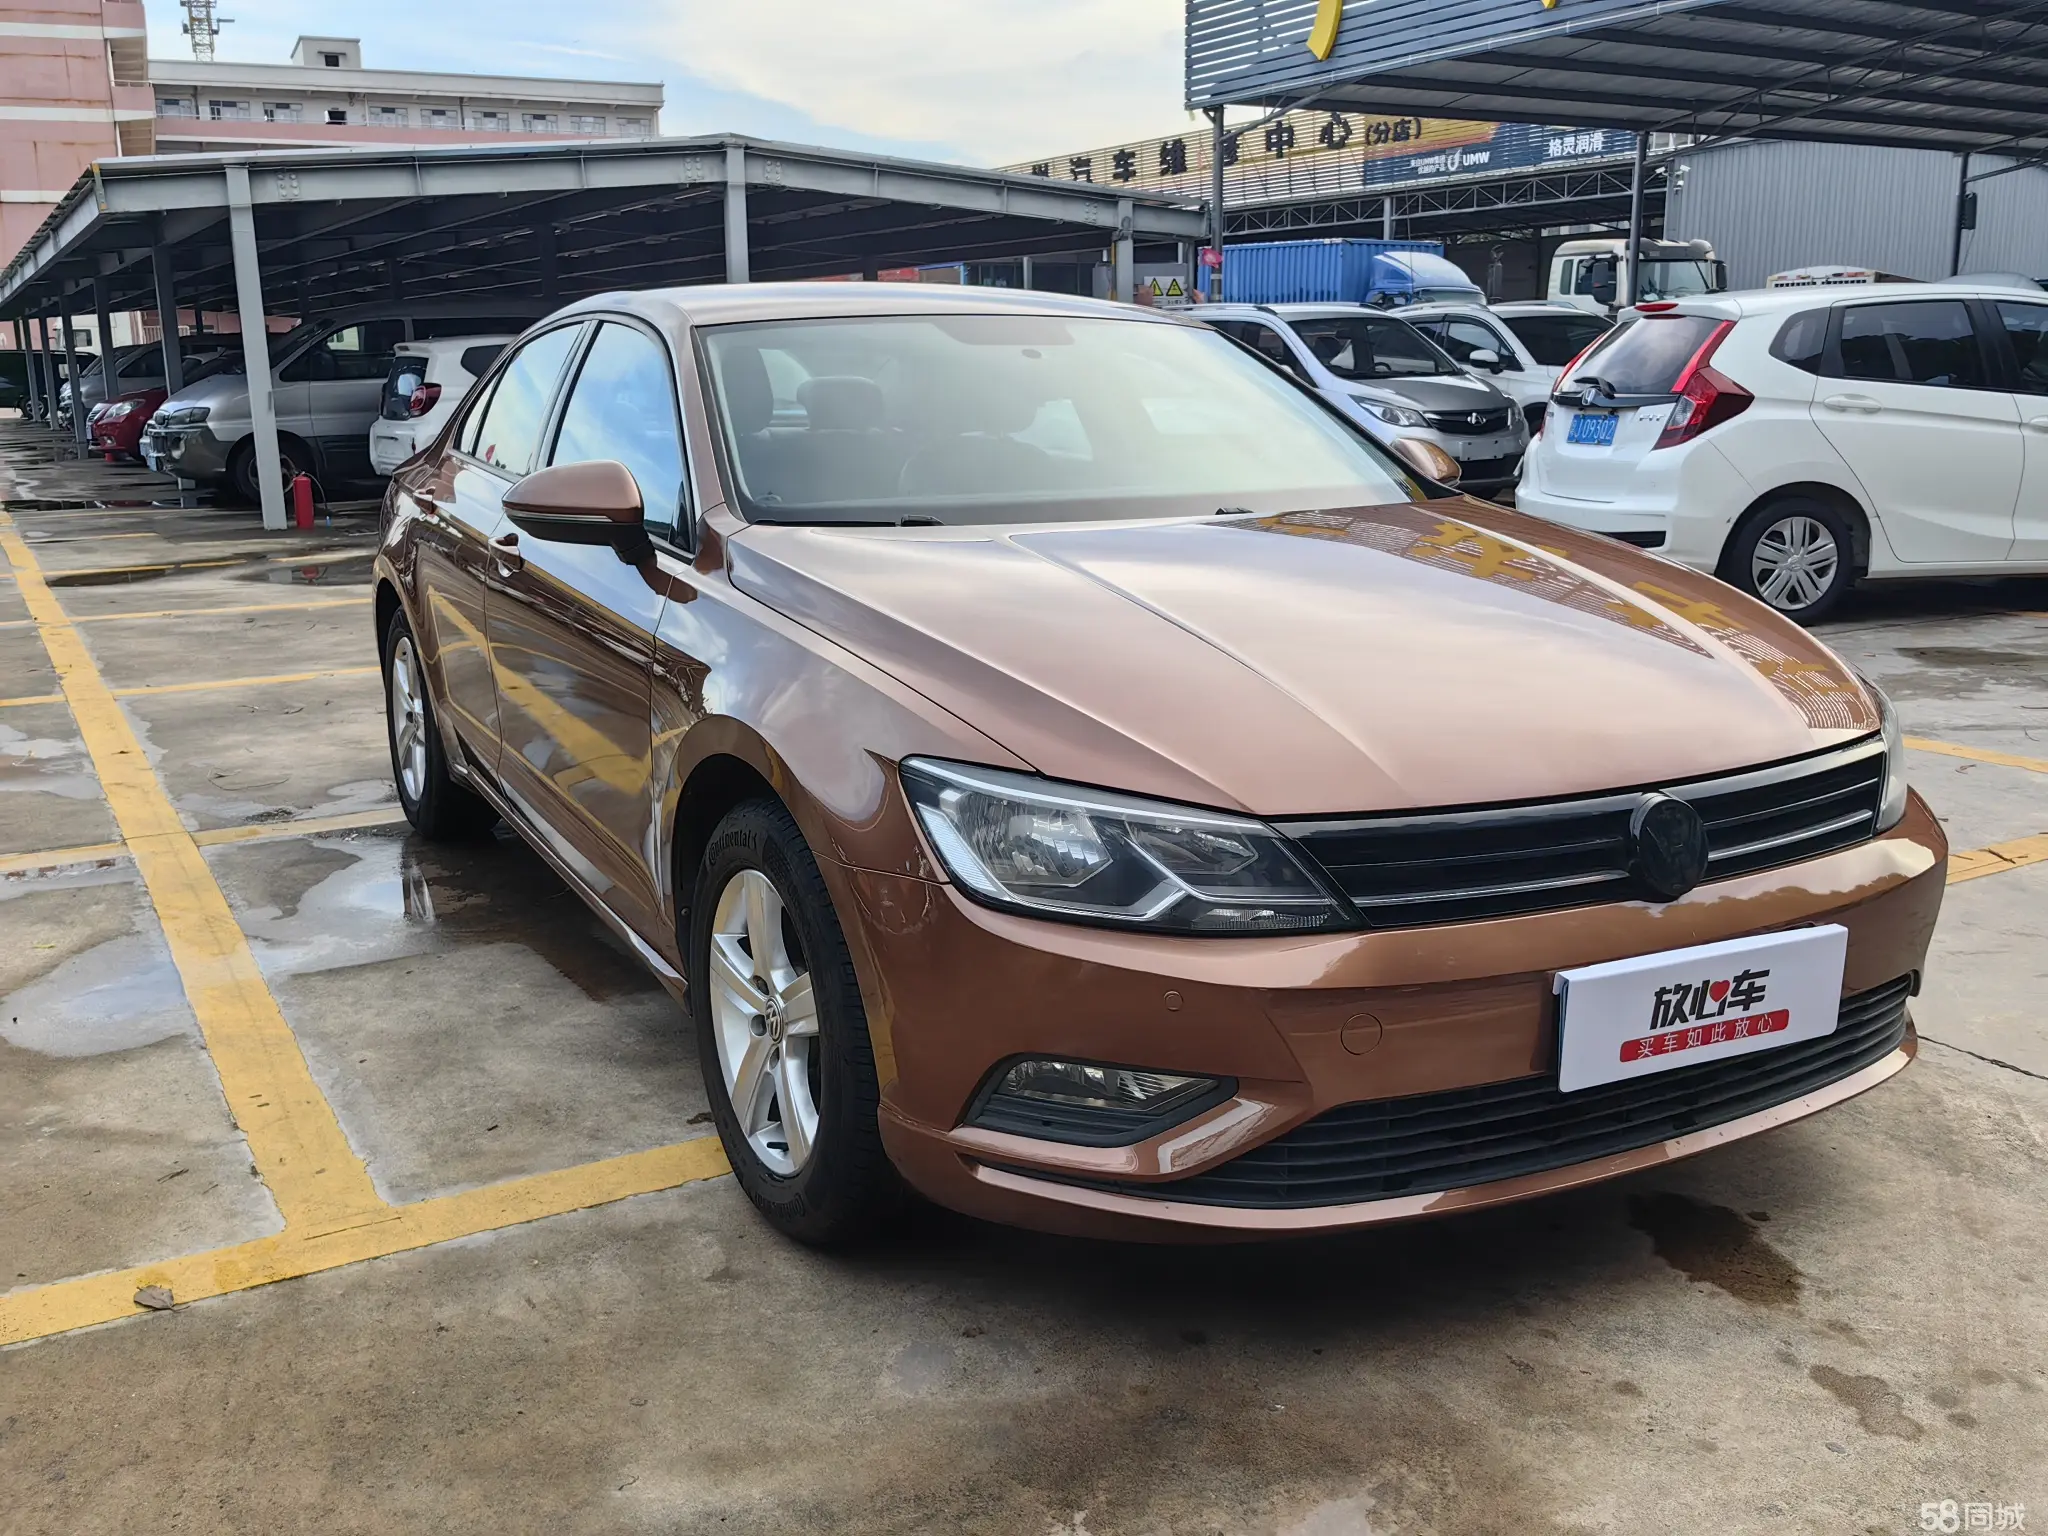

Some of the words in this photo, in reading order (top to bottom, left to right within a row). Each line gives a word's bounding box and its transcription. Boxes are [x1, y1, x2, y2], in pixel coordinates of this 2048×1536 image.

[1462, 151, 1490, 166] UMW
[1548, 132, 1604, 158] 格灵润滑
[1649, 969, 1771, 1031] 放心车
[1636, 1013, 1774, 1060] 买车如此放心
